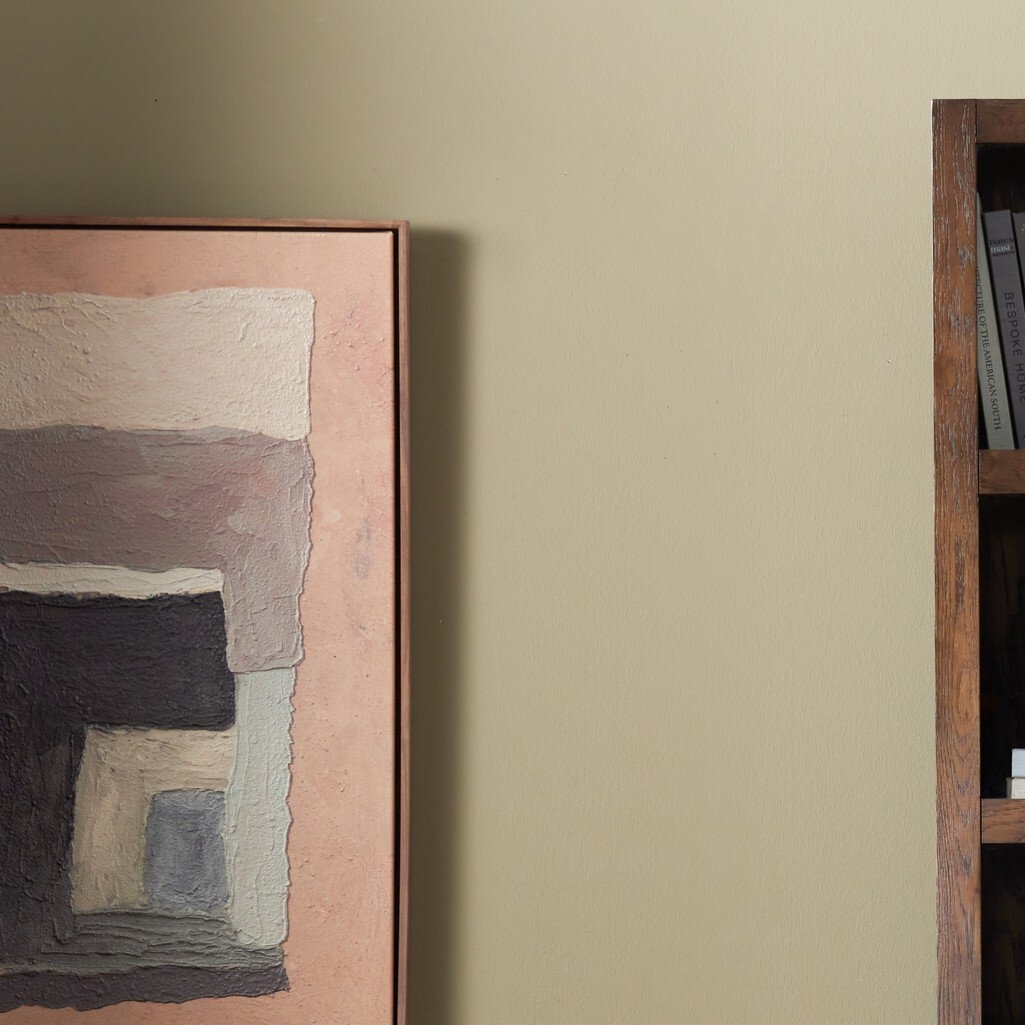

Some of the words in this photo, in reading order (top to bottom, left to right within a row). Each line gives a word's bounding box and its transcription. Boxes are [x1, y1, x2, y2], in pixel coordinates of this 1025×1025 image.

[979, 316, 988, 328] OF
[1004, 291, 1023, 357] BESPOKE
[980, 330, 991, 348] THE
[983, 349, 998, 397] AMERICAN
[990, 397, 1002, 430] SOUTH
